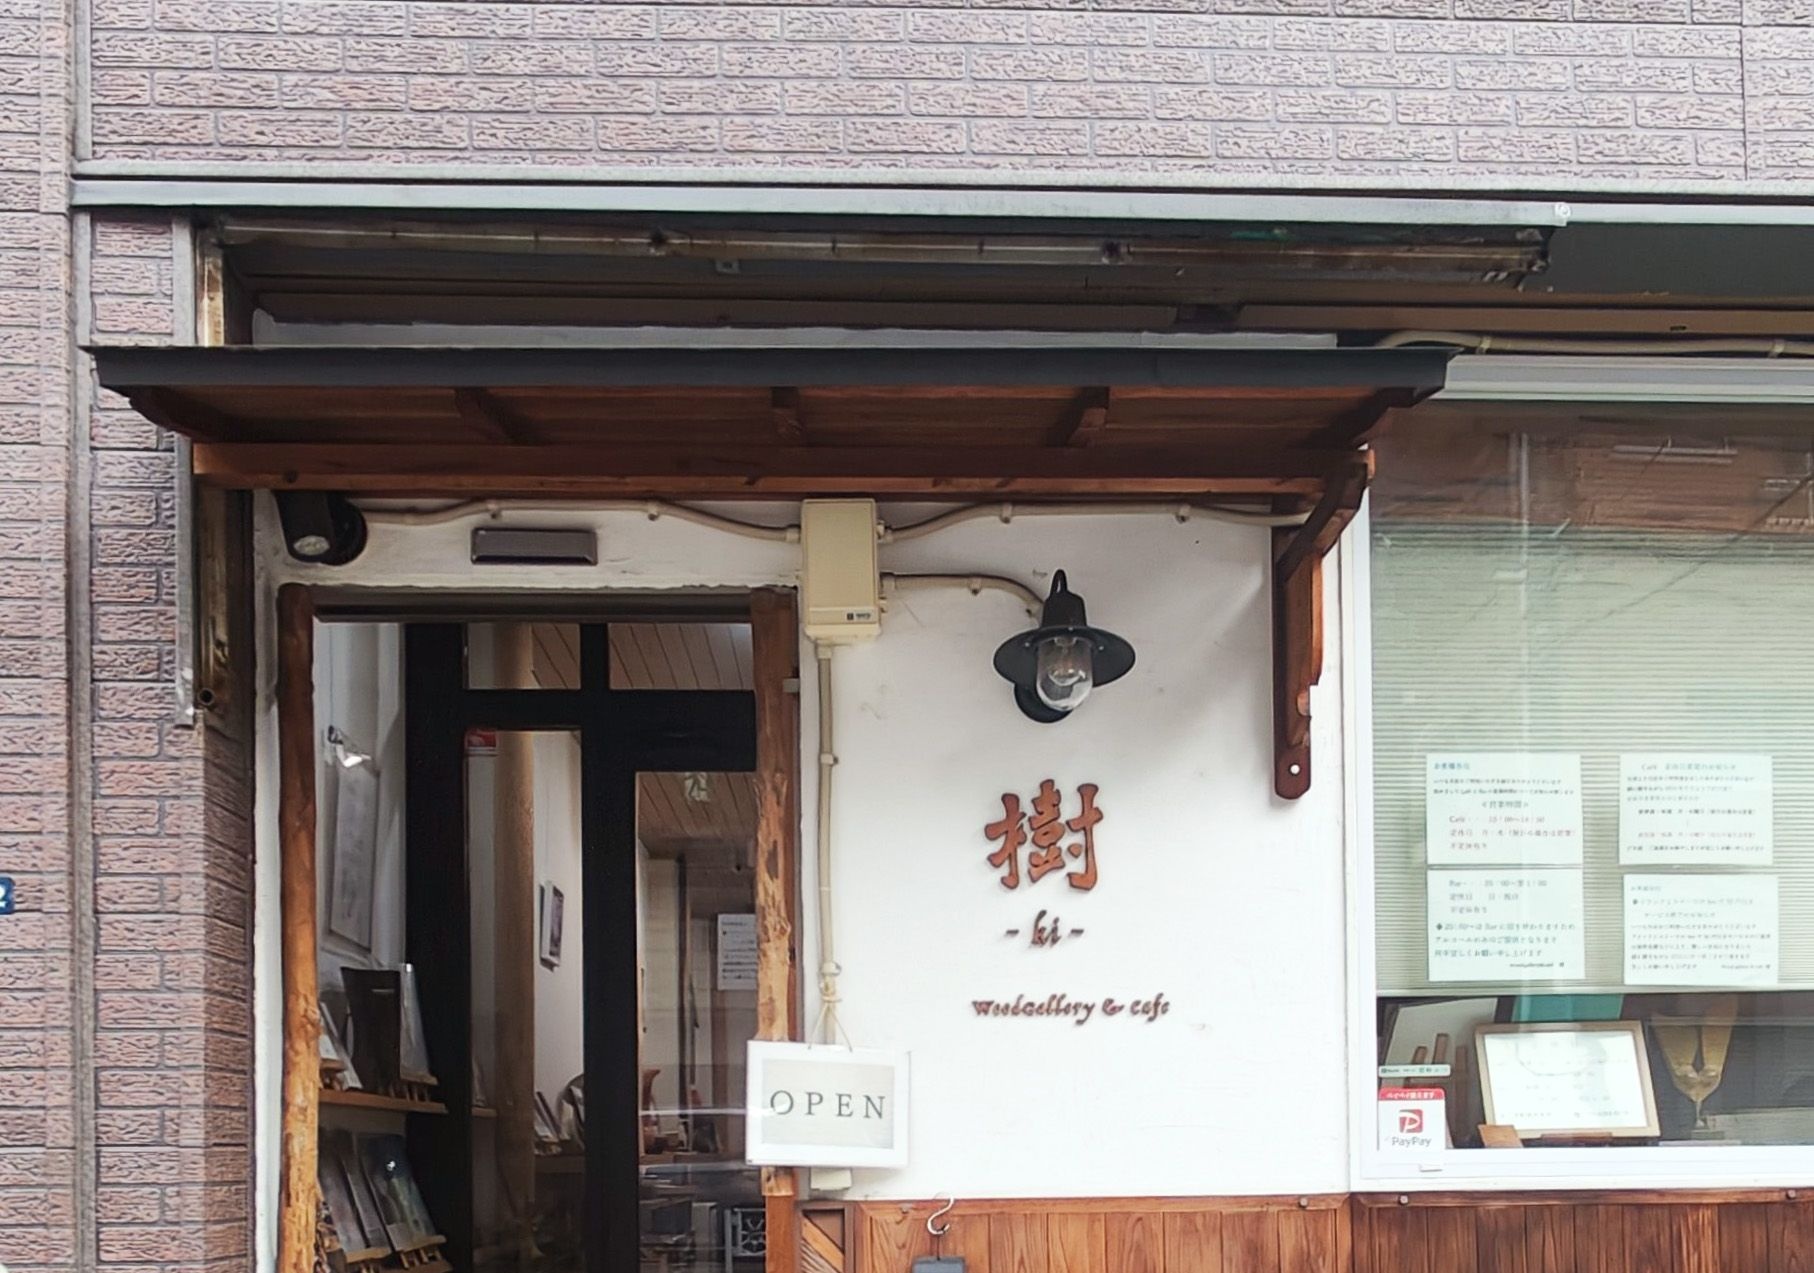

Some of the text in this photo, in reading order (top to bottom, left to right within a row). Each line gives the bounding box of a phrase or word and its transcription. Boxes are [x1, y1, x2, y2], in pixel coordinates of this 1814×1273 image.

[984, 778, 1104, 891] 樹
[1101, 998, 1124, 1016] &
[769, 1090, 887, 1120] OPEN
[1391, 1136, 1432, 1147] PayPay
